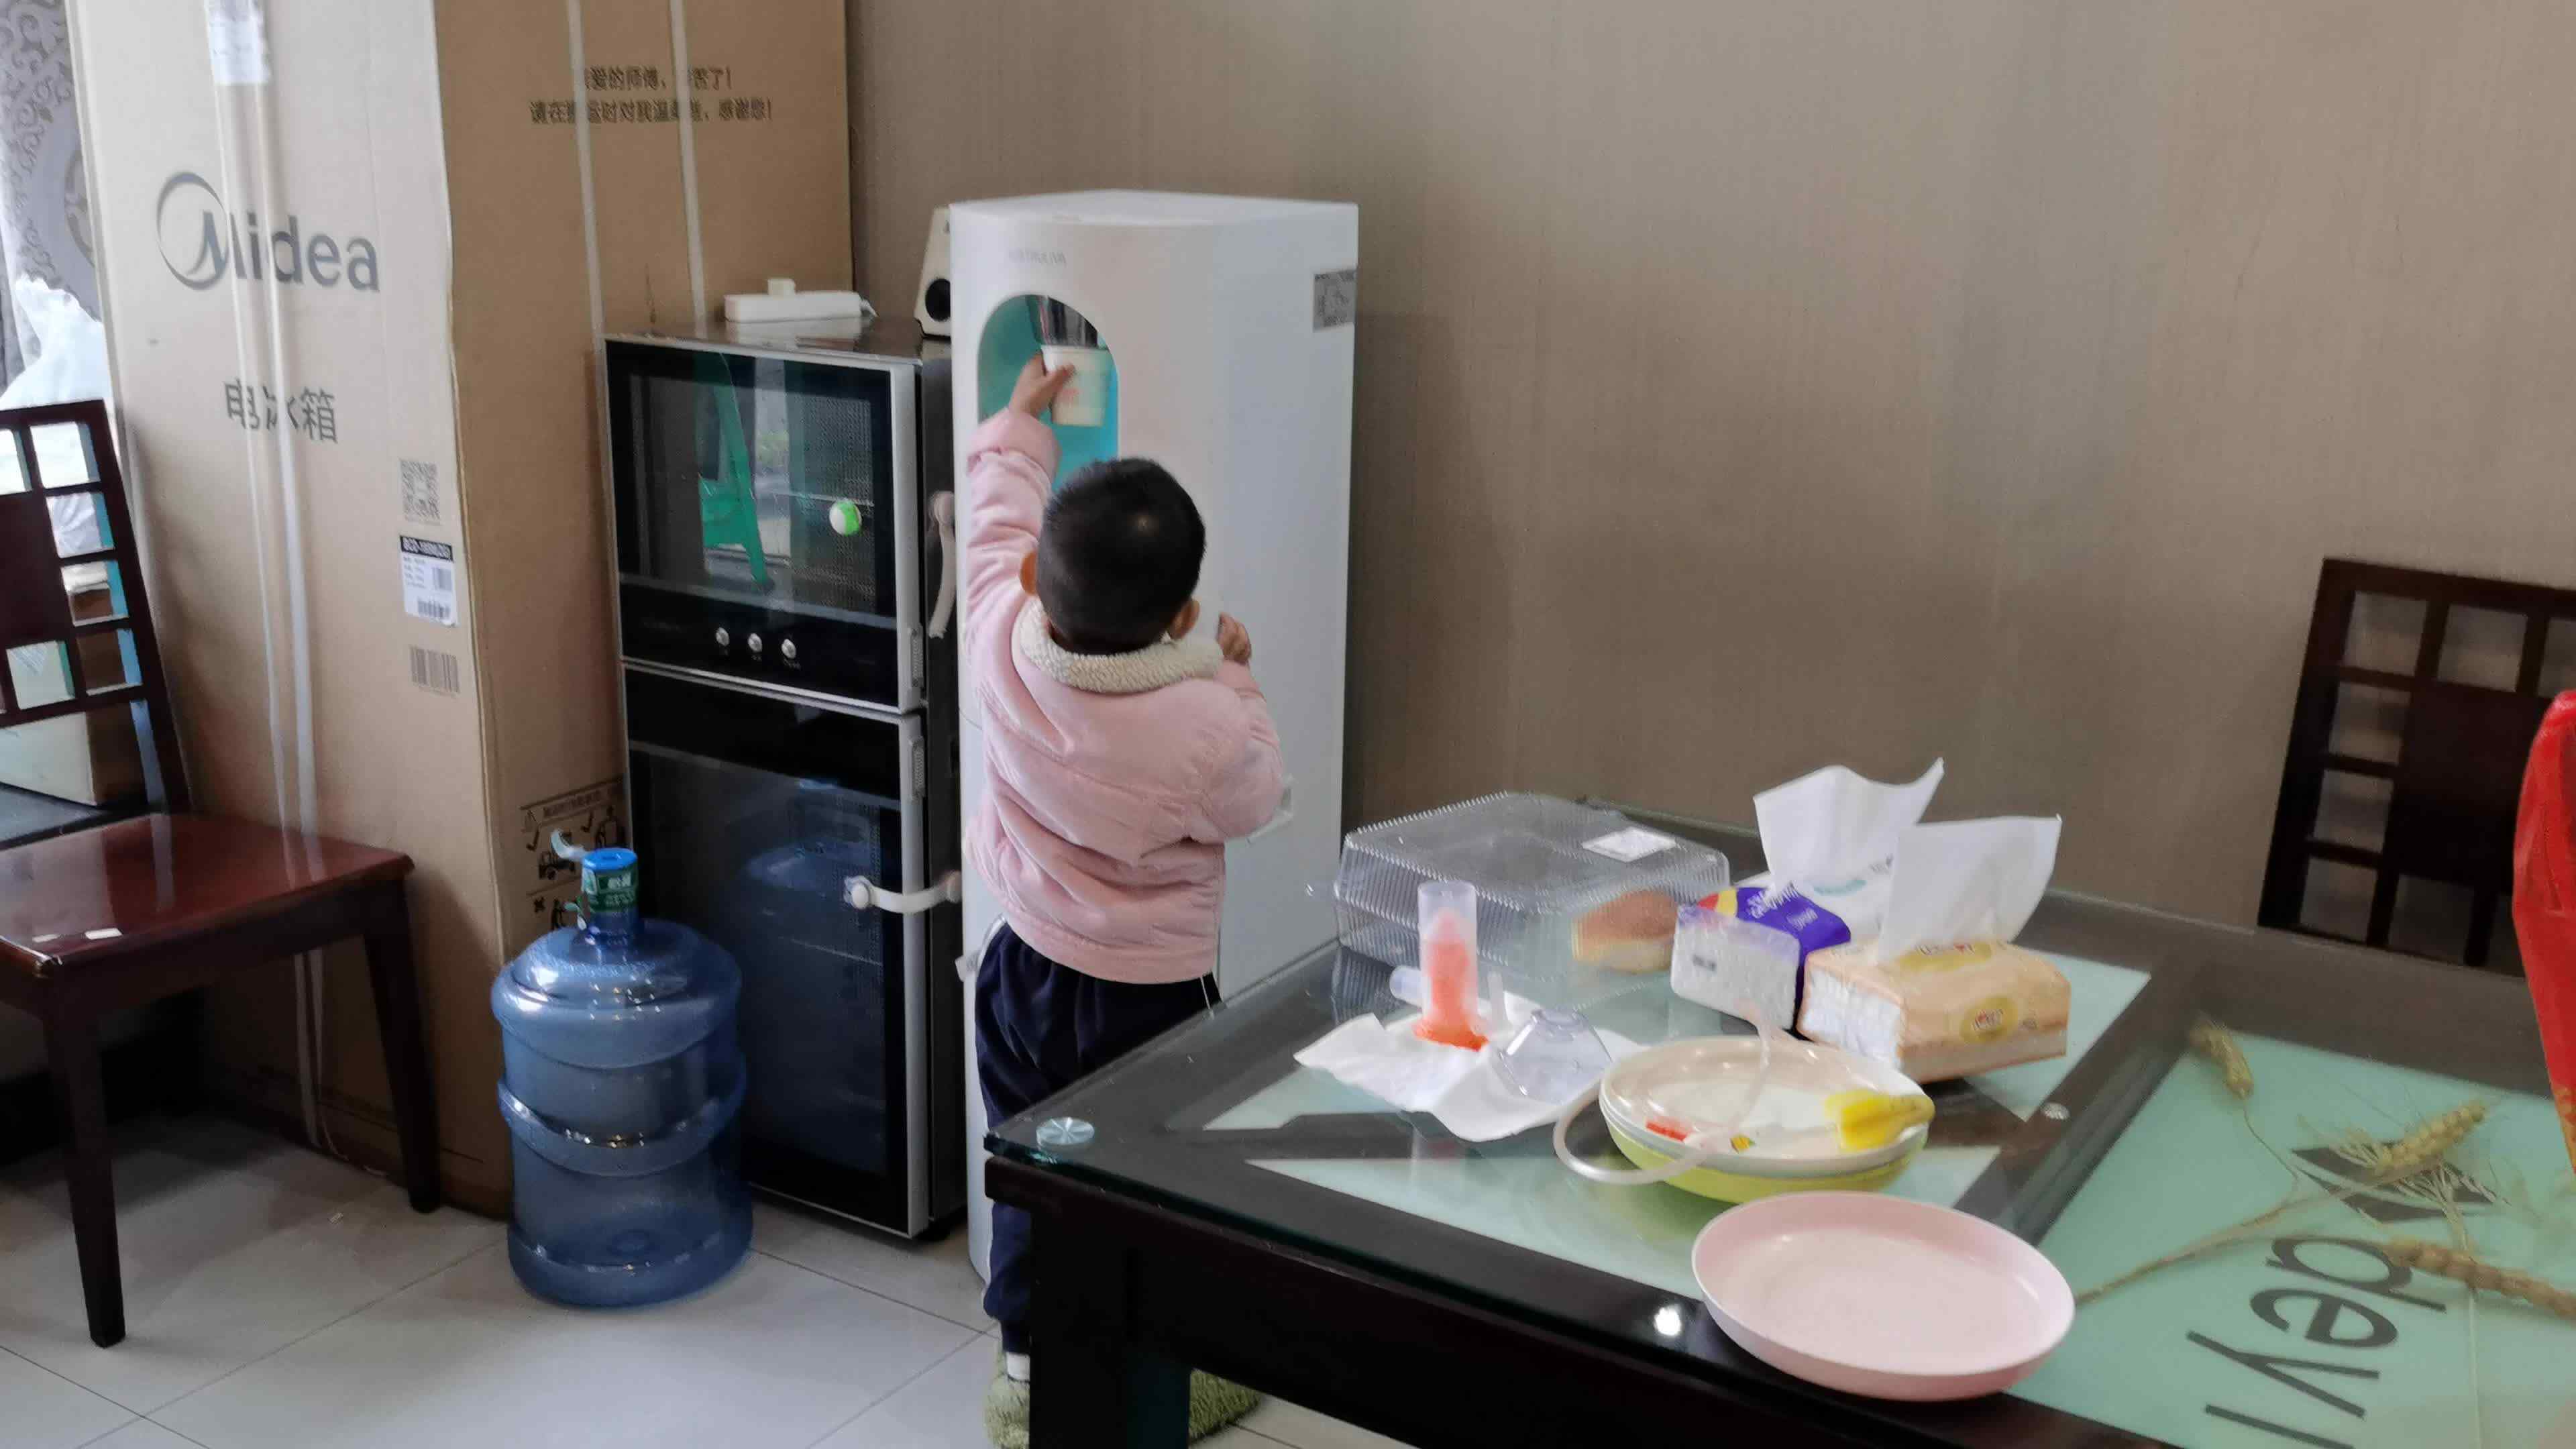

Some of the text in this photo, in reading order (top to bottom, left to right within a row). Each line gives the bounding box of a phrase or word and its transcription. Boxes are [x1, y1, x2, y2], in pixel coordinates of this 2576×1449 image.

[156, 170, 380, 293] Midea
[223, 378, 338, 444] 电冰箱
